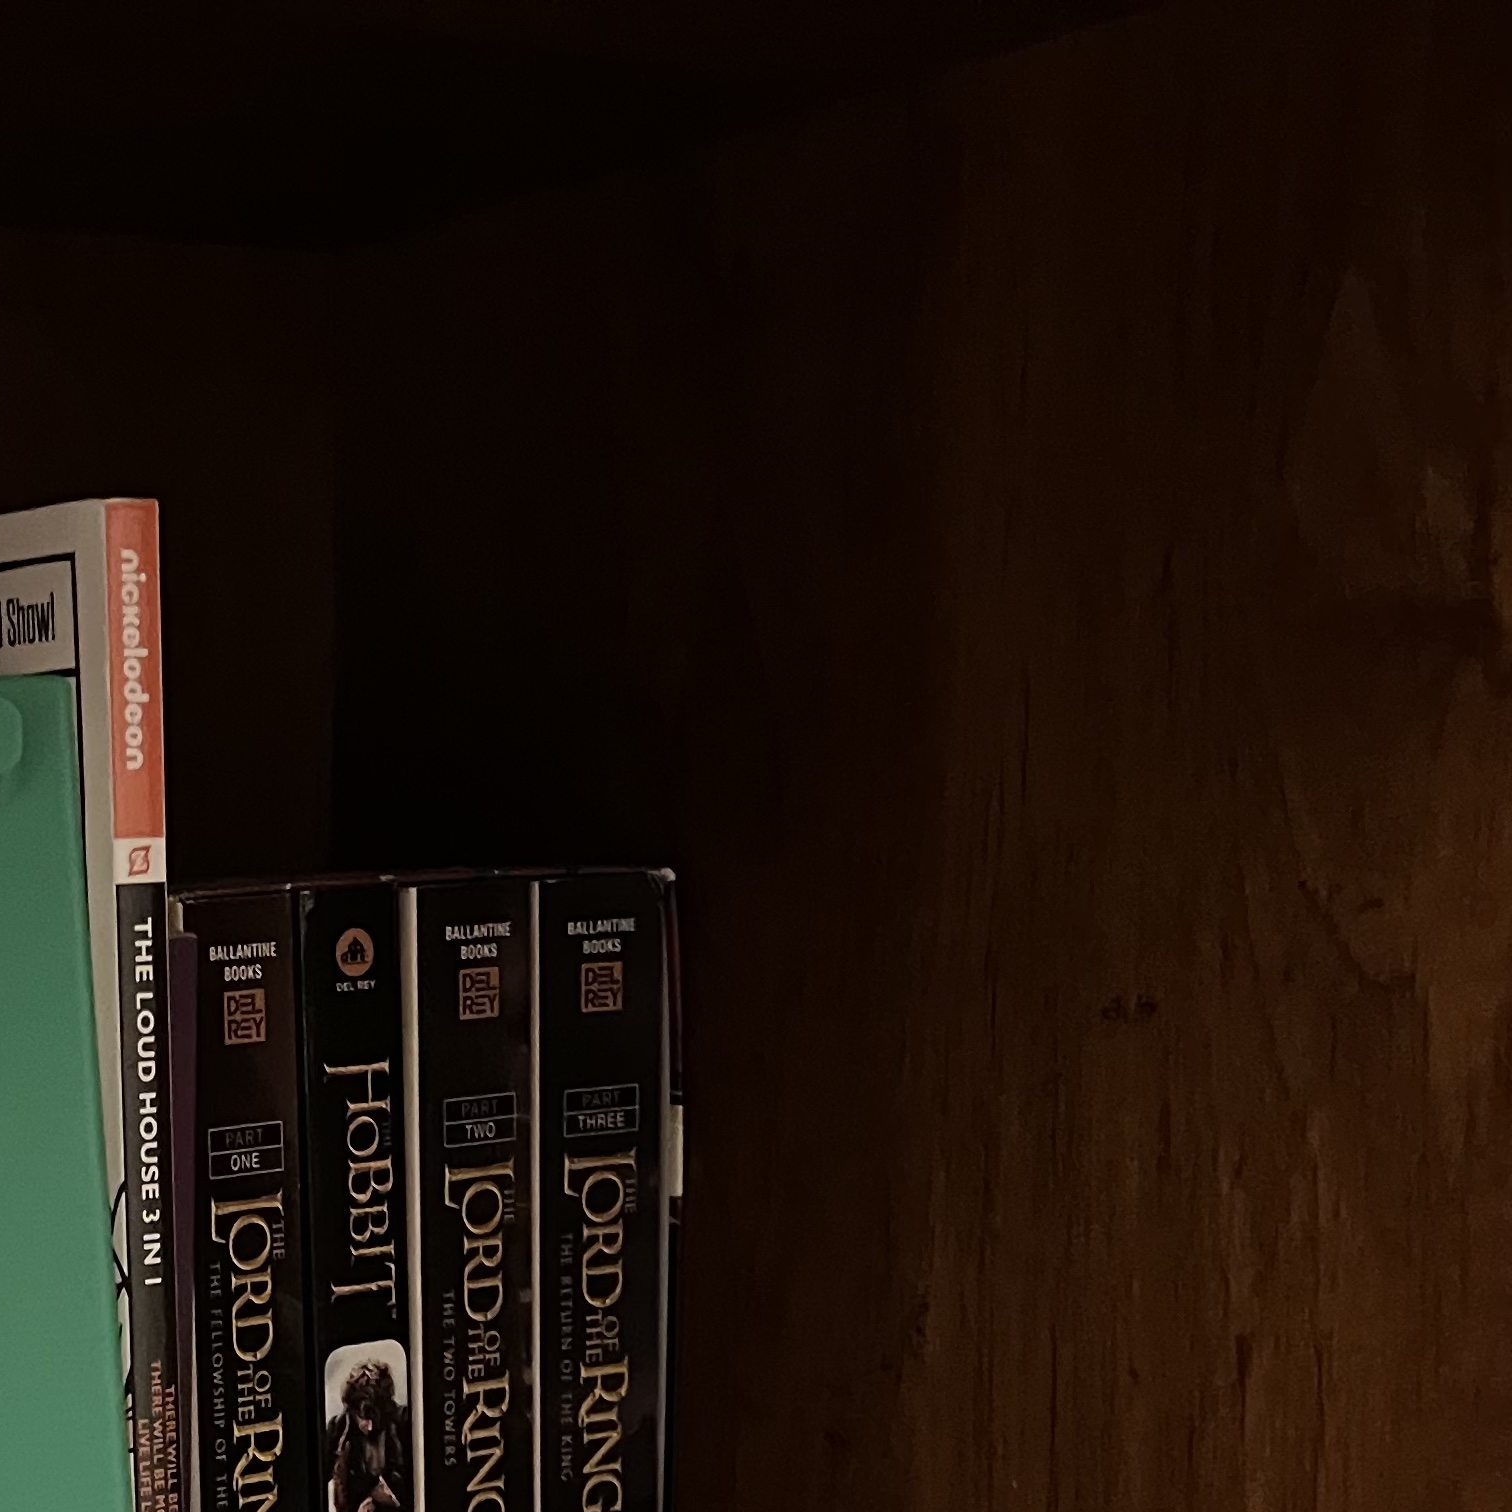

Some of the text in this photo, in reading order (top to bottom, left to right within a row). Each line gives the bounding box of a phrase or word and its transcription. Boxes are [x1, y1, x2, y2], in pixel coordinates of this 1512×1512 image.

[6, 590, 57, 647] Show!
[119, 547, 152, 772] nickelodeon
[445, 921, 512, 942] BALLANTINE
[567, 917, 637, 938] BALLANTINE
[582, 936, 622, 955] BOOKS
[209, 941, 278, 963] BALLANTINE
[460, 941, 499, 960] BOOKS
[224, 962, 263, 983] BOOKS
[462, 970, 498, 993] DEL
[584, 964, 621, 988] DEL
[227, 992, 263, 1016] DEL
[462, 993, 499, 1016] REY
[586, 987, 622, 1009] REY
[227, 1017, 265, 1041] REY
[134, 917, 162, 1267] THE LOUD HOUSE 3 IN
[462, 1098, 498, 1119] PART
[581, 1089, 622, 1108] PART
[225, 1126, 264, 1149] PART
[464, 1120, 498, 1140] TWO
[577, 1109, 626, 1130] THREE
[230, 1151, 262, 1172] ONE
[323, 1056, 398, 1320] HOBBIT
[271, 1215, 287, 1261] THE
[444, 1156, 516, 1322] LORD
[564, 1147, 638, 1309] LORD
[209, 1261, 221, 1301] THE
[211, 1190, 286, 1362] LORD
[466, 1322, 488, 1378] THE
[483, 1330, 501, 1367] OF
[585, 1309, 605, 1364] THE
[603, 1315, 621, 1352] OF
[211, 1306, 226, 1429] FELLOWSHIP
[441, 1288, 457, 1468] THE TWO TOWERS
[150, 1360, 164, 1416] THERE
[235, 1362, 257, 1421] THE
[254, 1367, 273, 1409] OF
[137, 1419, 153, 1497] LIVE LIFE
[152, 1419, 166, 1465] WILL
[215, 1437, 227, 1463] OF
[216, 1471, 229, 1512] THE
